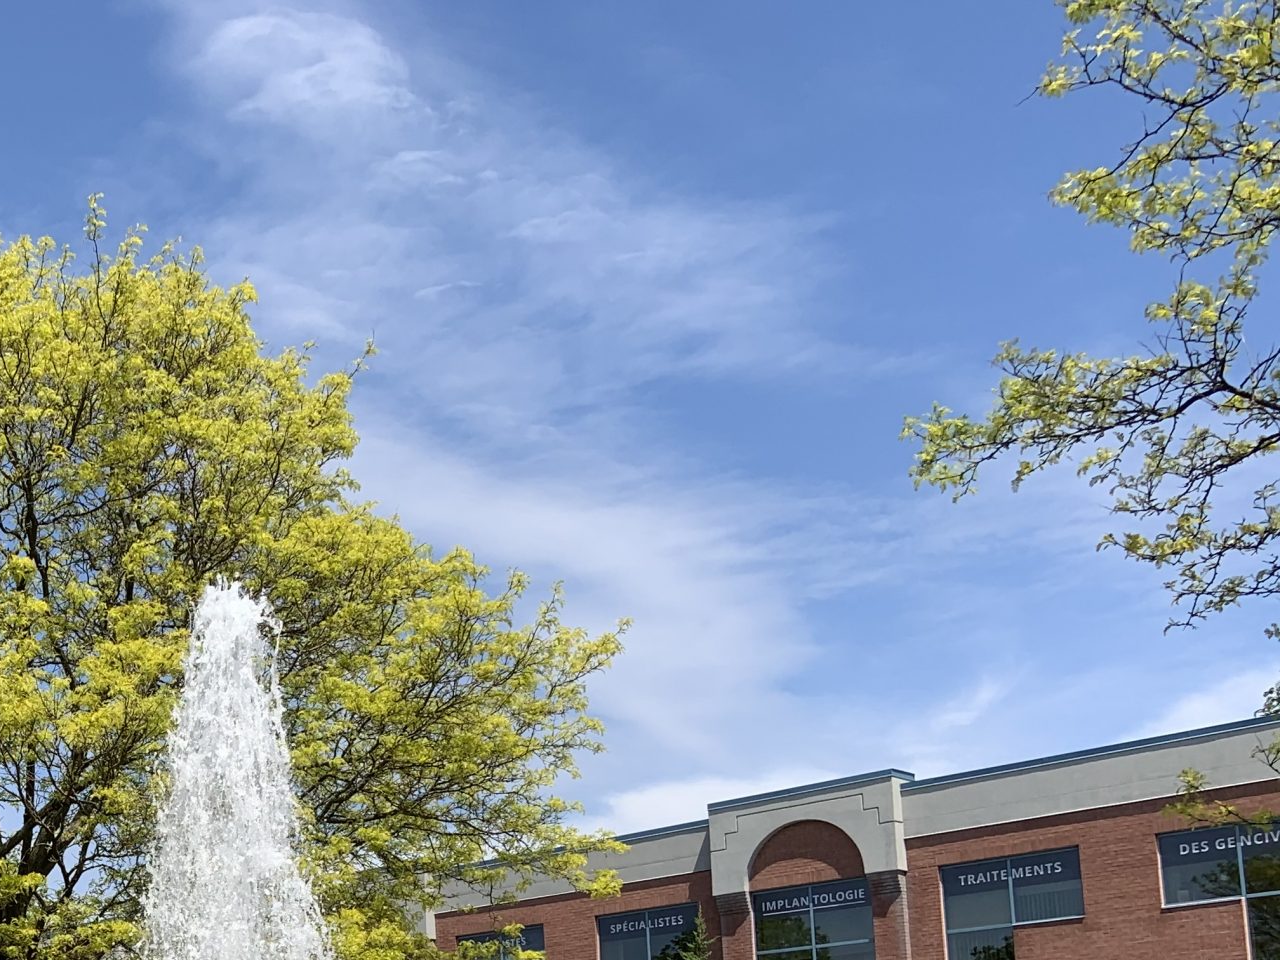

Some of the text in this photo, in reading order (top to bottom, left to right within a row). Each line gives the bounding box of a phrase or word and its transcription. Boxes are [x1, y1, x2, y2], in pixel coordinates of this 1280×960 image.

[1179, 830, 1280, 855] DES GENCIV
[959, 862, 1062, 886] TRAITEMENTS
[762, 888, 865, 912] IMPLANTOLOGIE
[610, 915, 683, 934] SPÉCIALISTES
